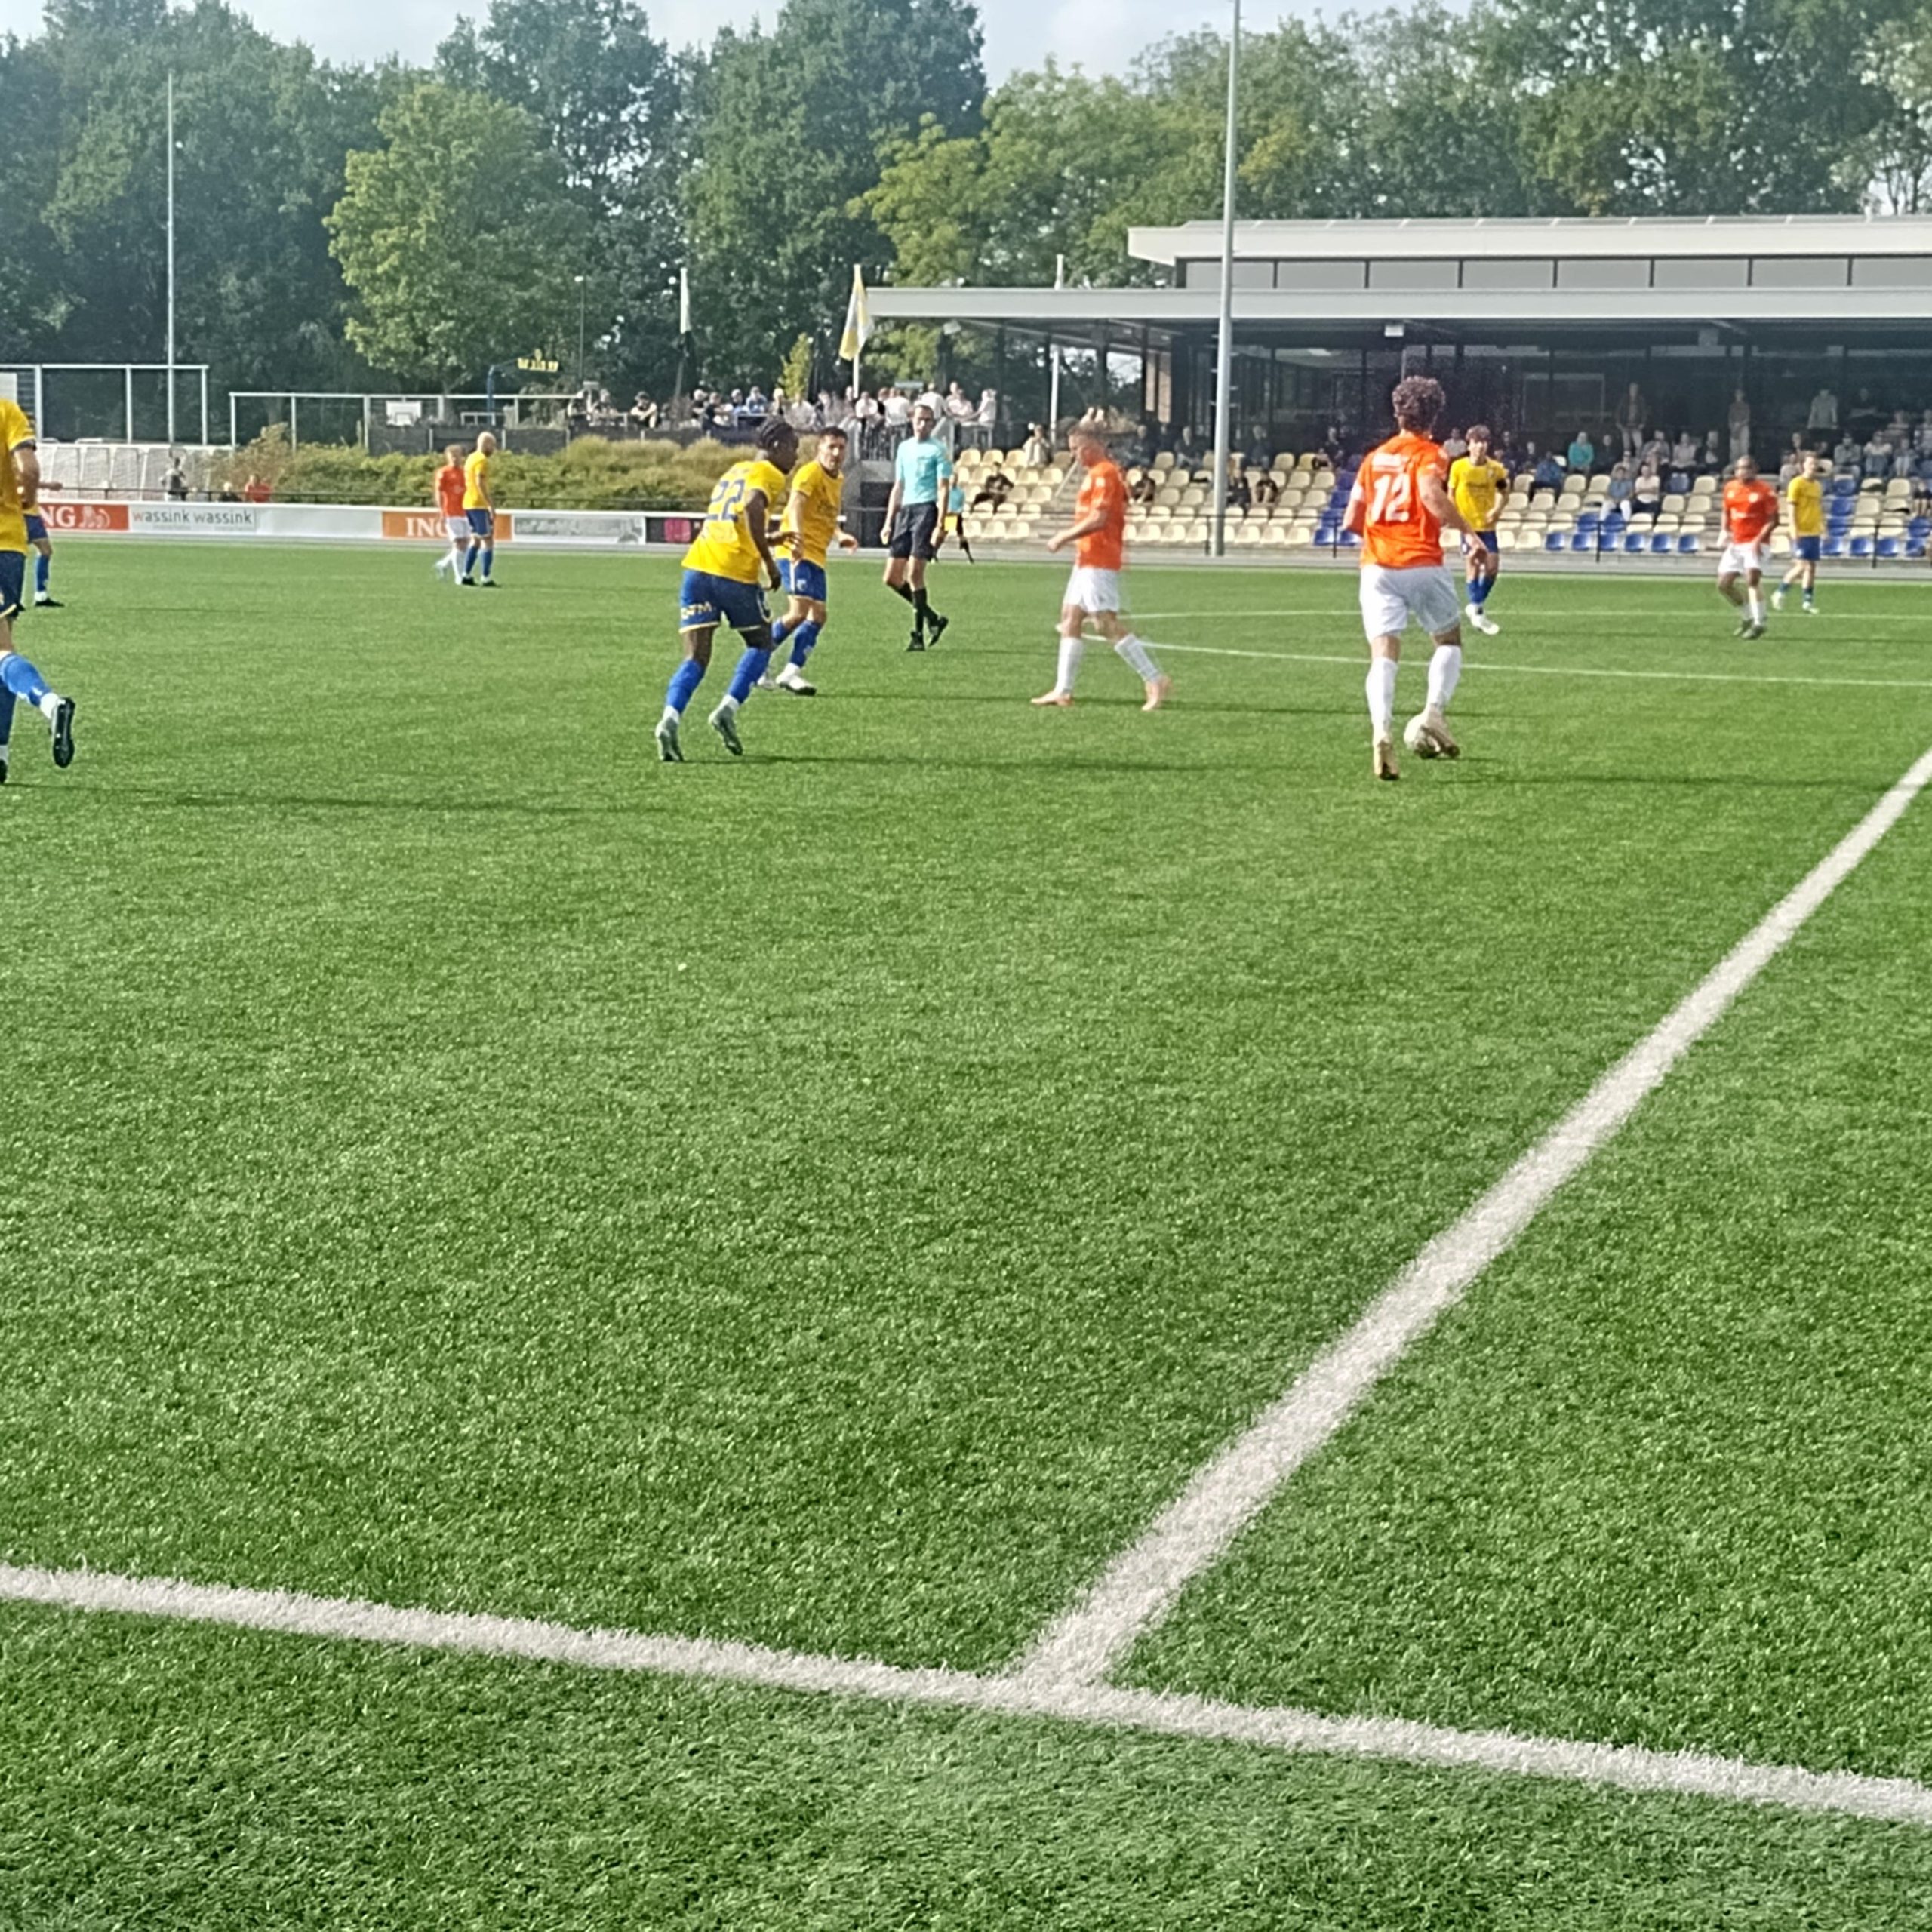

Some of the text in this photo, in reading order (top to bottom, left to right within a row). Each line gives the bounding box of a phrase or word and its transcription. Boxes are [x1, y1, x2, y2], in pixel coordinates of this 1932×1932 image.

[709, 478, 744, 521] 22
[39, 505, 76, 528] NG
[133, 509, 252, 524] wassink wassink
